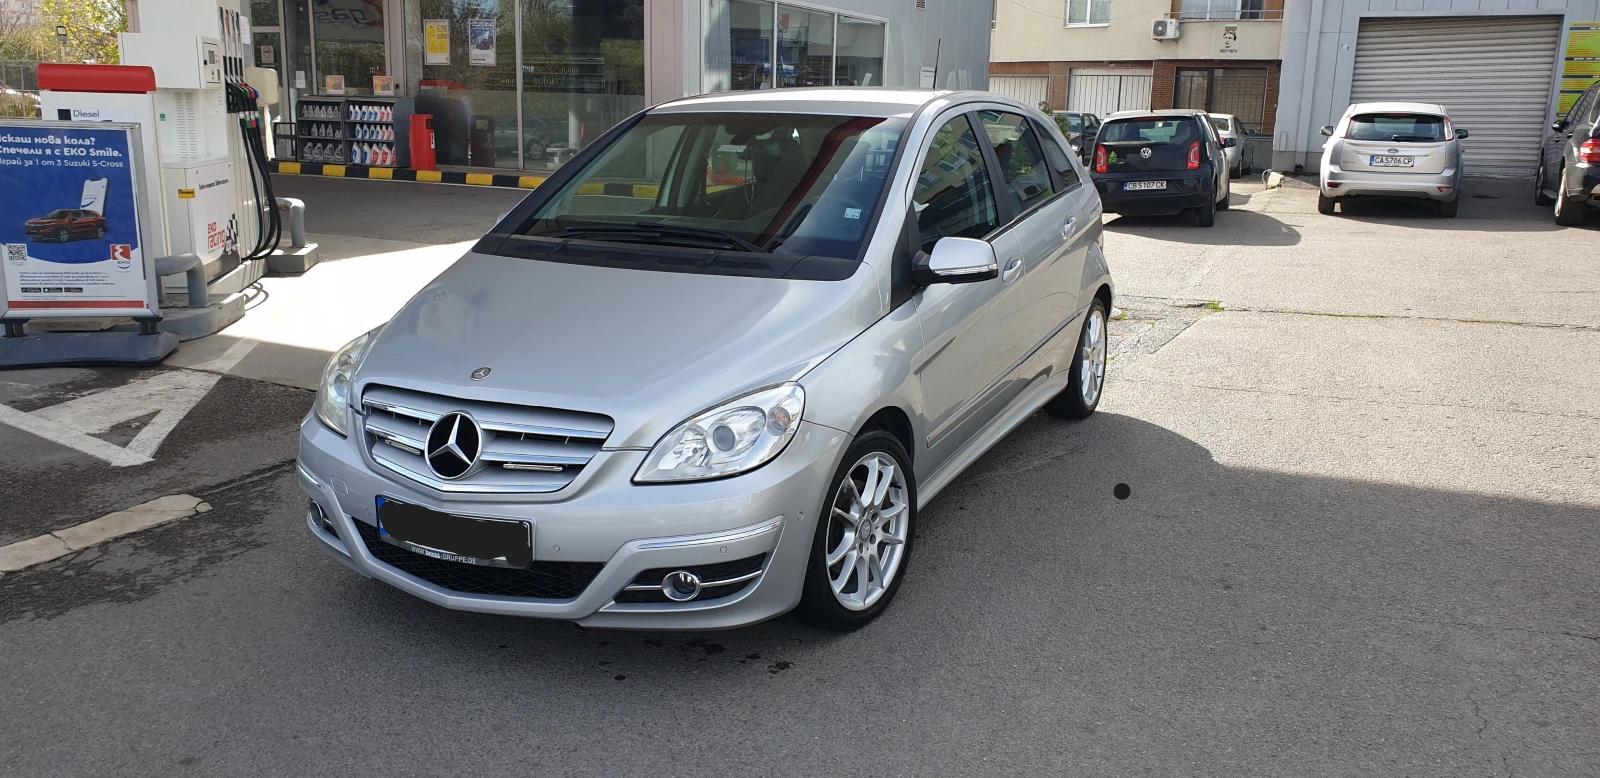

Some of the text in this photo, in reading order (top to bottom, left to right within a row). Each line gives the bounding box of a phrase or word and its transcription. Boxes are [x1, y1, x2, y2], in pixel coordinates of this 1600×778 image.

[73, 109, 100, 118] Diesel
[0, 133, 96, 145] скаш нова кола?
[0, 145, 42, 155] Спечели
[64, 147, 87, 156] EKO
[89, 147, 122, 157] Smile.
[24, 159, 33, 167] за
[92, 160, 124, 168] S-Cross
[207, 222, 217, 233] EKO
